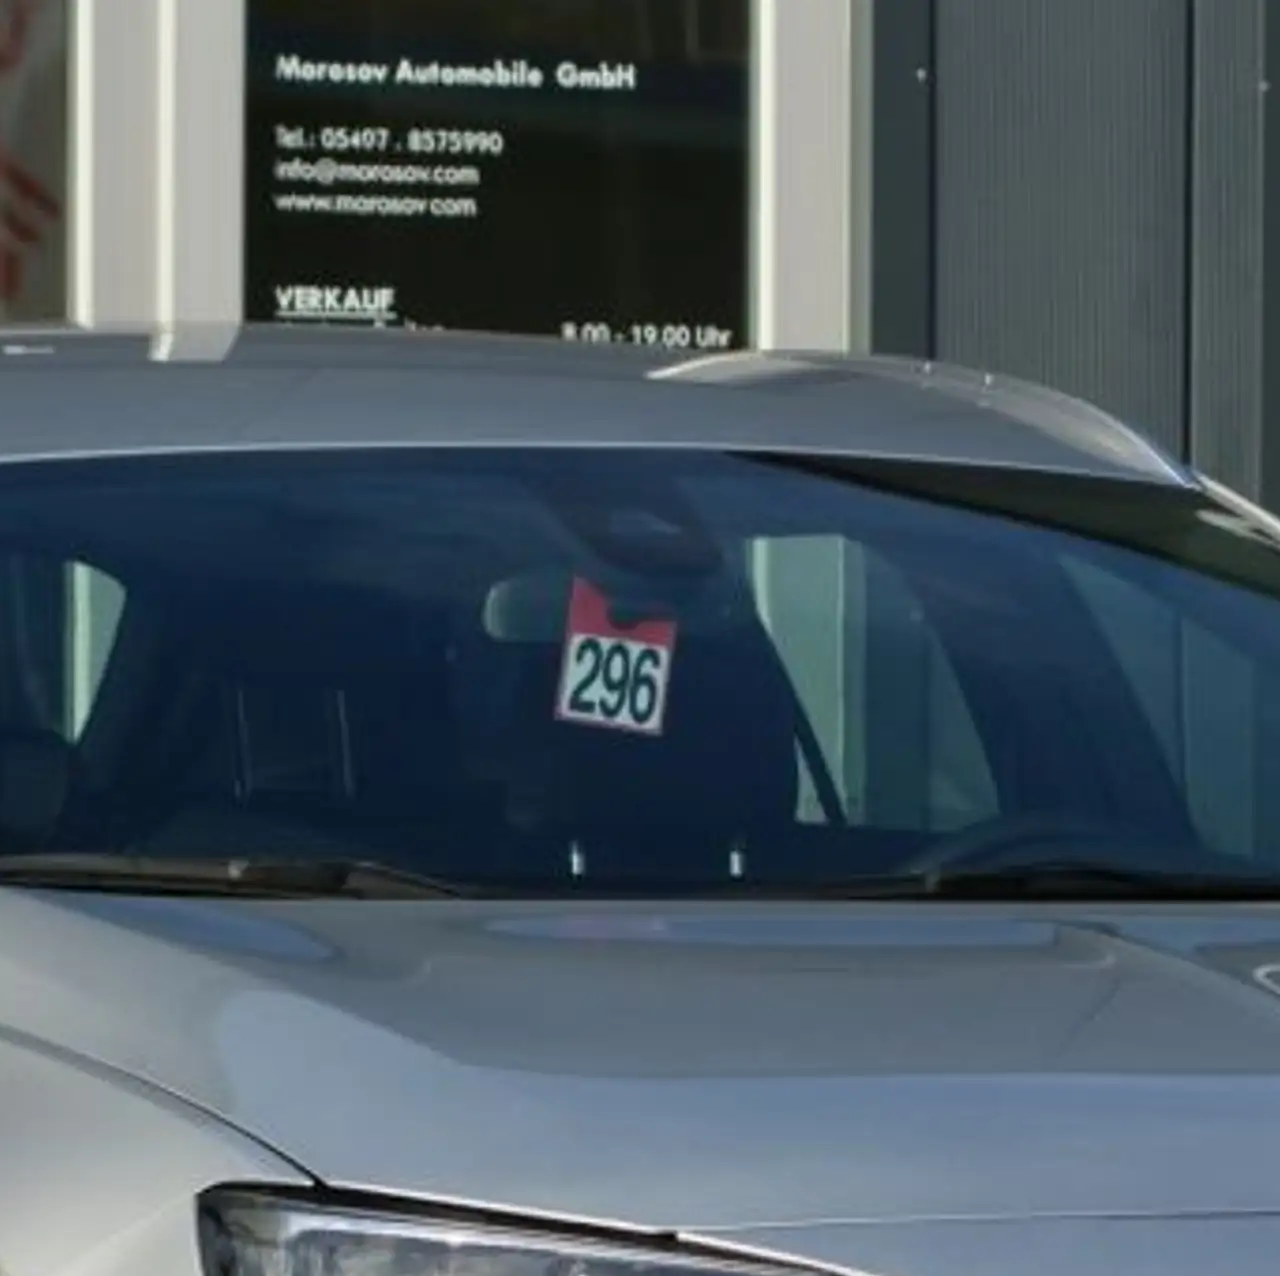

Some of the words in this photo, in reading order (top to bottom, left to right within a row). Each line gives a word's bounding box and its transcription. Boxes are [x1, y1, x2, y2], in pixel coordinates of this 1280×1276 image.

[275, 54, 388, 83] Morosov
[394, 56, 543, 88] Automobile
[556, 61, 636, 89] GmbH
[320, 126, 390, 151] 05407
[407, 127, 504, 155] 8575990
[275, 157, 480, 185] info@morosov.com
[274, 193, 477, 217] www.morosov.com
[275, 285, 396, 312] VERKAUF
[695, 324, 732, 347] Uhr
[569, 637, 660, 724] 296
